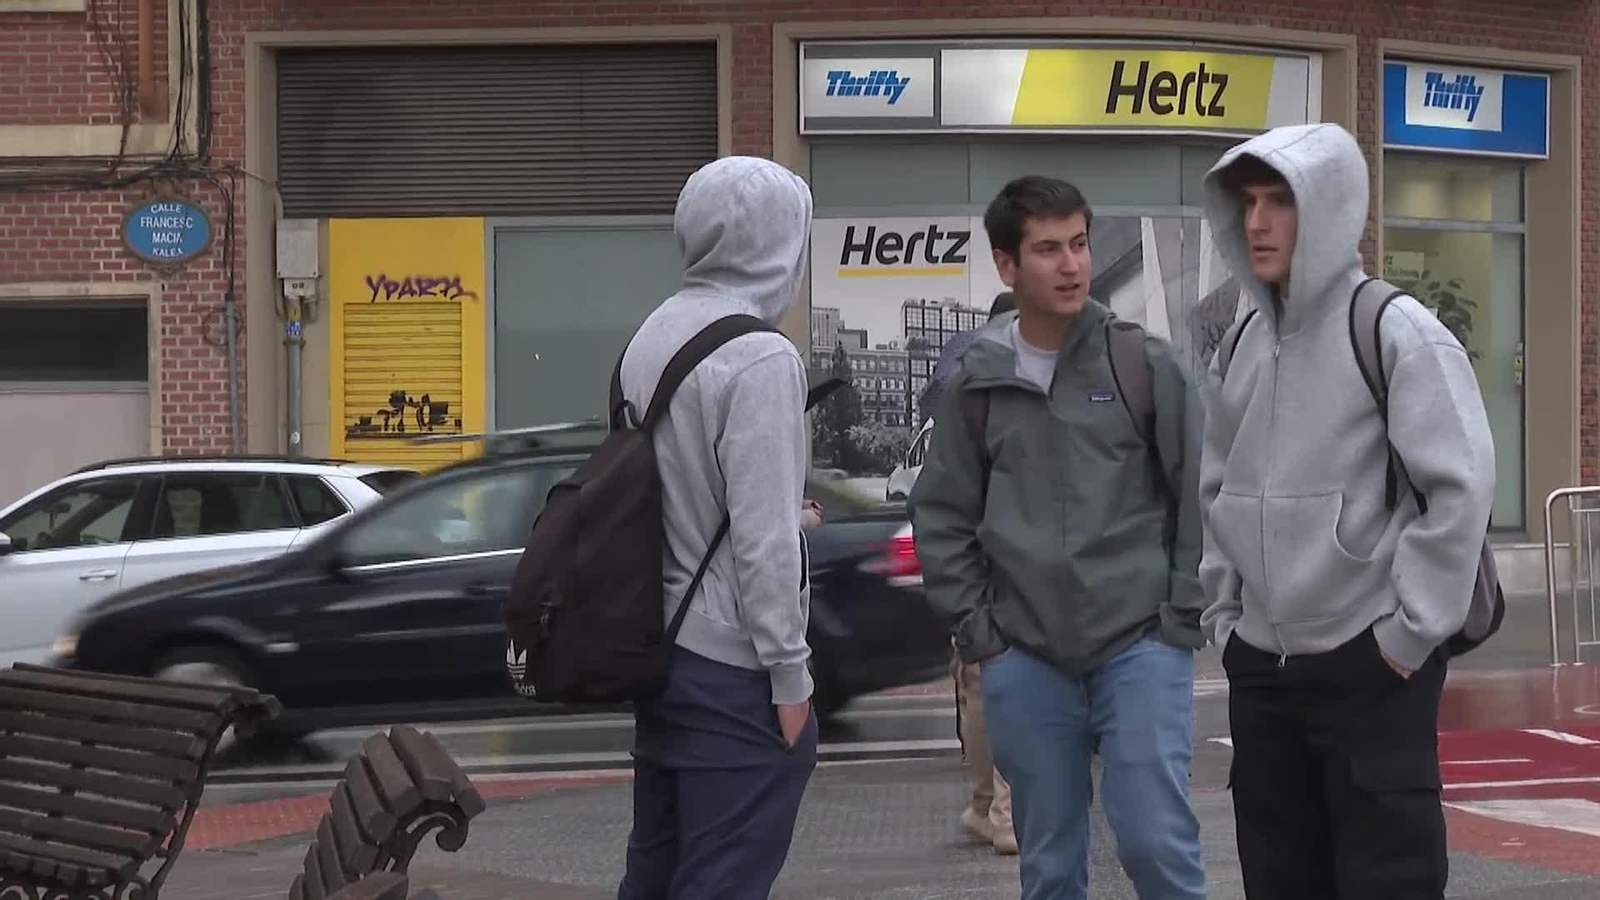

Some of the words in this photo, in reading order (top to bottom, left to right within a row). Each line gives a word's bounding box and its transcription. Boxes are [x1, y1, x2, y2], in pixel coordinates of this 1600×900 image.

[826, 70, 910, 105] Thrifty
[1105, 60, 1229, 117] Hertz
[1423, 71, 1485, 122] Thrifty
[140, 216, 193, 229] FRANCESC
[150, 203, 183, 214] CALLE
[840, 224, 971, 265] Hertz
